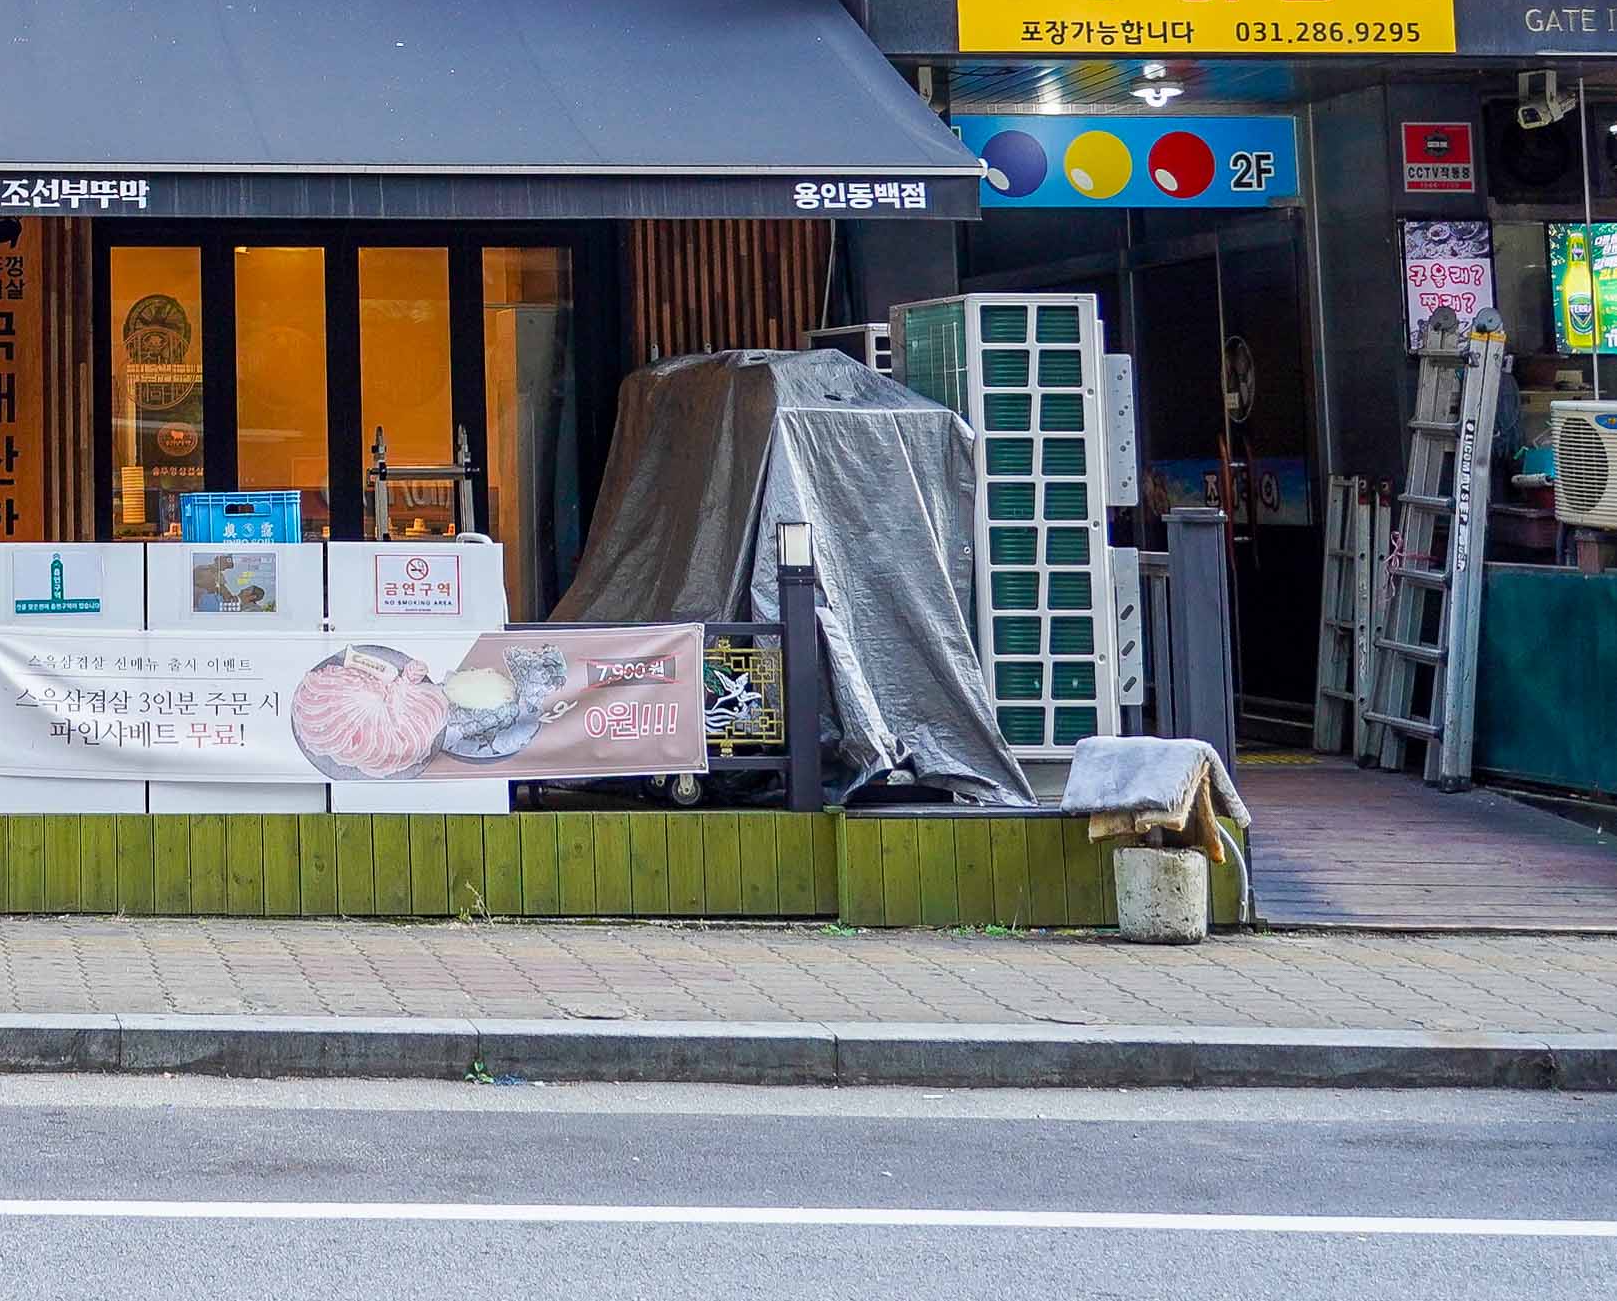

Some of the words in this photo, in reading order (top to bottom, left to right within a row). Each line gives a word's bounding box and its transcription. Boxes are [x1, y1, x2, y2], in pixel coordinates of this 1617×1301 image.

[1021, 20, 1195, 45] 포장가능합니다
[1235, 20, 1422, 44] 031.286.9295
[1525, 8, 1598, 32] GATE
[1229, 151, 1275, 192] 2F
[0, 179, 150, 209] 조선부뚜막
[793, 182, 927, 209] 용인동백점
[384, 582, 451, 597] 금연구역
[206, 657, 253, 672] 이벤트
[139, 690, 199, 716] 3인분
[204, 690, 253, 716] 주문
[259, 690, 280, 717] 시
[50, 718, 180, 749] 파인샤베트
[186, 722, 246, 749] 무료!
